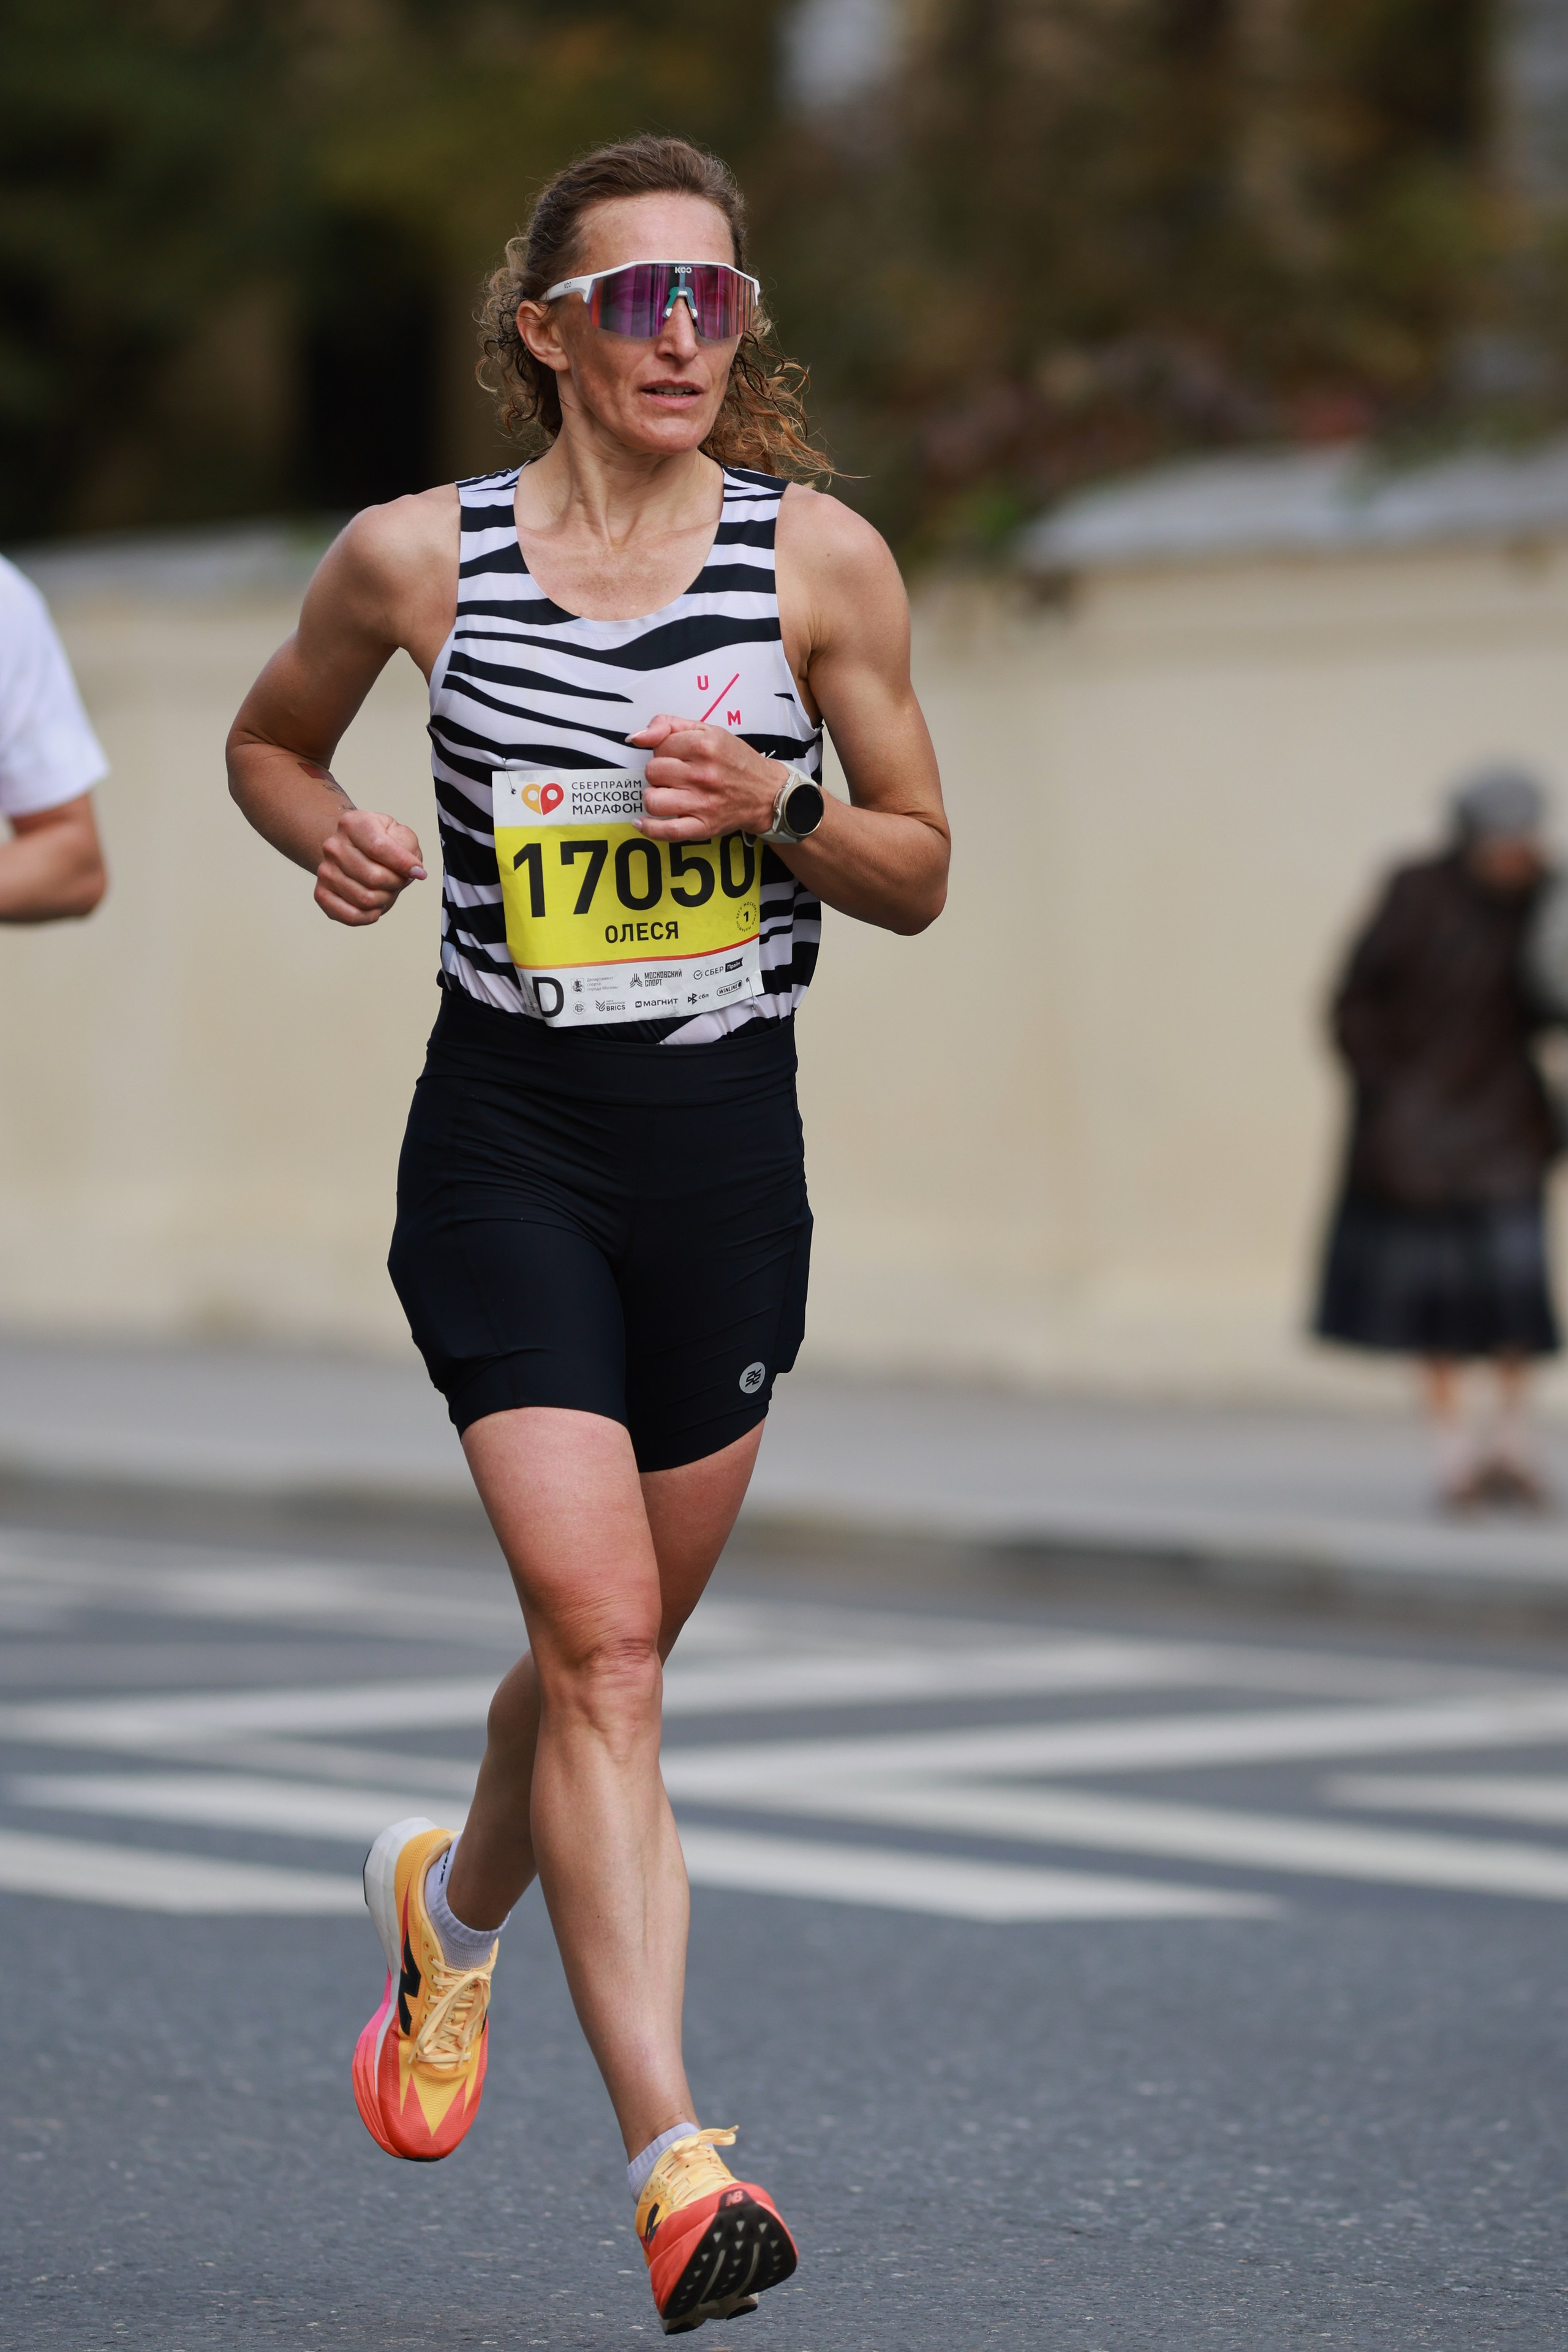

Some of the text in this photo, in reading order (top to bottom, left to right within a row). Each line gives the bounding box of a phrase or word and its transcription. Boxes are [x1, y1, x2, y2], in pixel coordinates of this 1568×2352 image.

[571, 778, 642, 790] СБЕРПРАЙМ
[573, 802, 643, 815] МАРАФОН
[513, 831, 755, 918] 17050
[744, 911, 749, 922] 1
[605, 921, 679, 943] ОЛЕСЯ
[644, 968, 682, 979] МОСКОВСКИЙ
[704, 966, 724, 976] СБЕР
[645, 979, 662, 987] СПОРТ
[719, 983, 738, 994] WINLINE
[532, 976, 564, 1018] D
